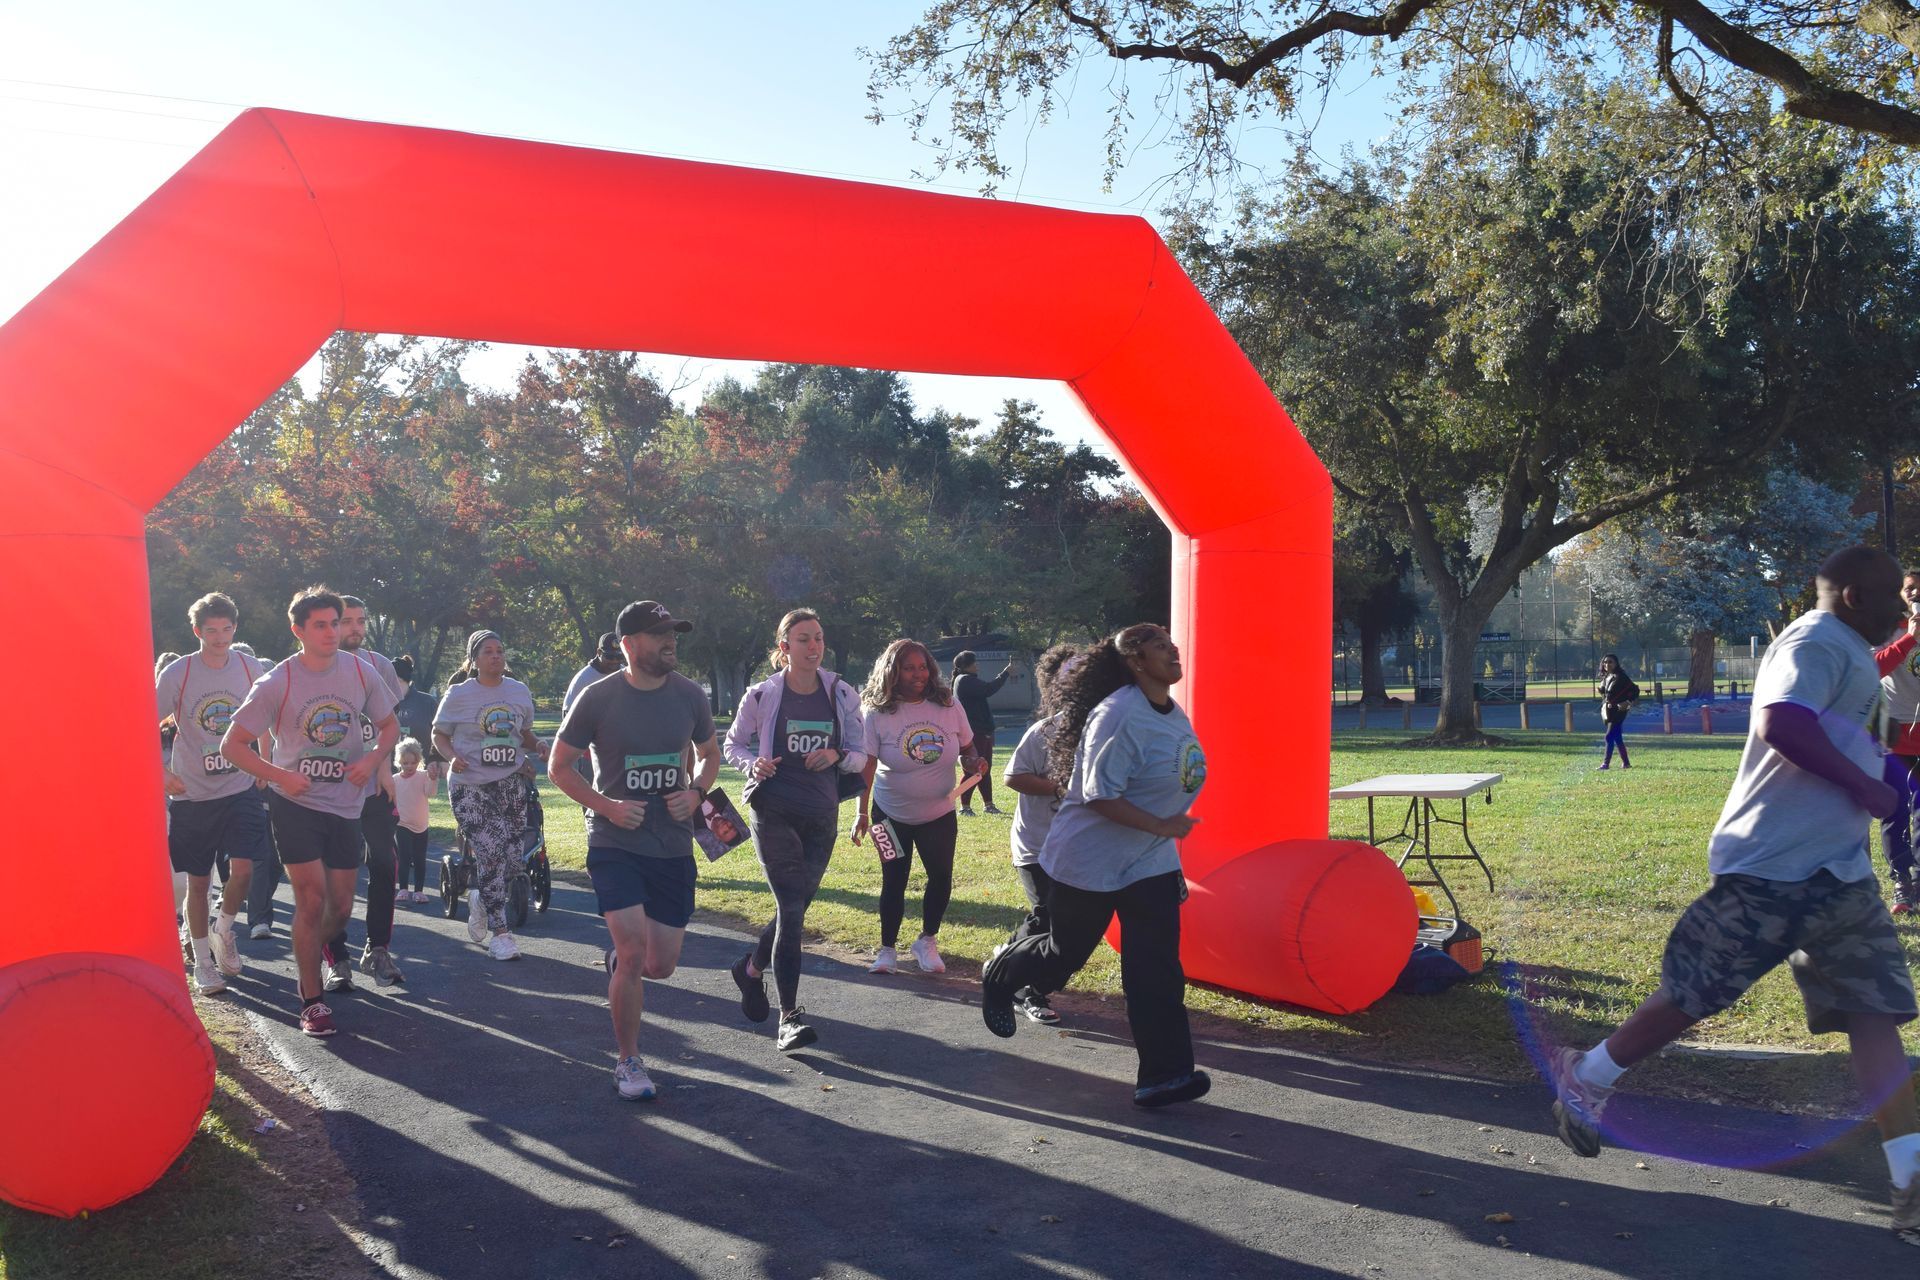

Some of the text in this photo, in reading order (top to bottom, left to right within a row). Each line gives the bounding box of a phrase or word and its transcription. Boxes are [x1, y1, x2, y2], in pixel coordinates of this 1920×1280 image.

[787, 733, 829, 754] 6021
[204, 755, 233, 771] 600
[482, 748, 515, 762] 6012
[300, 759, 344, 778] 6003
[626, 768, 677, 790] 6019
[871, 823, 896, 860] 6029
